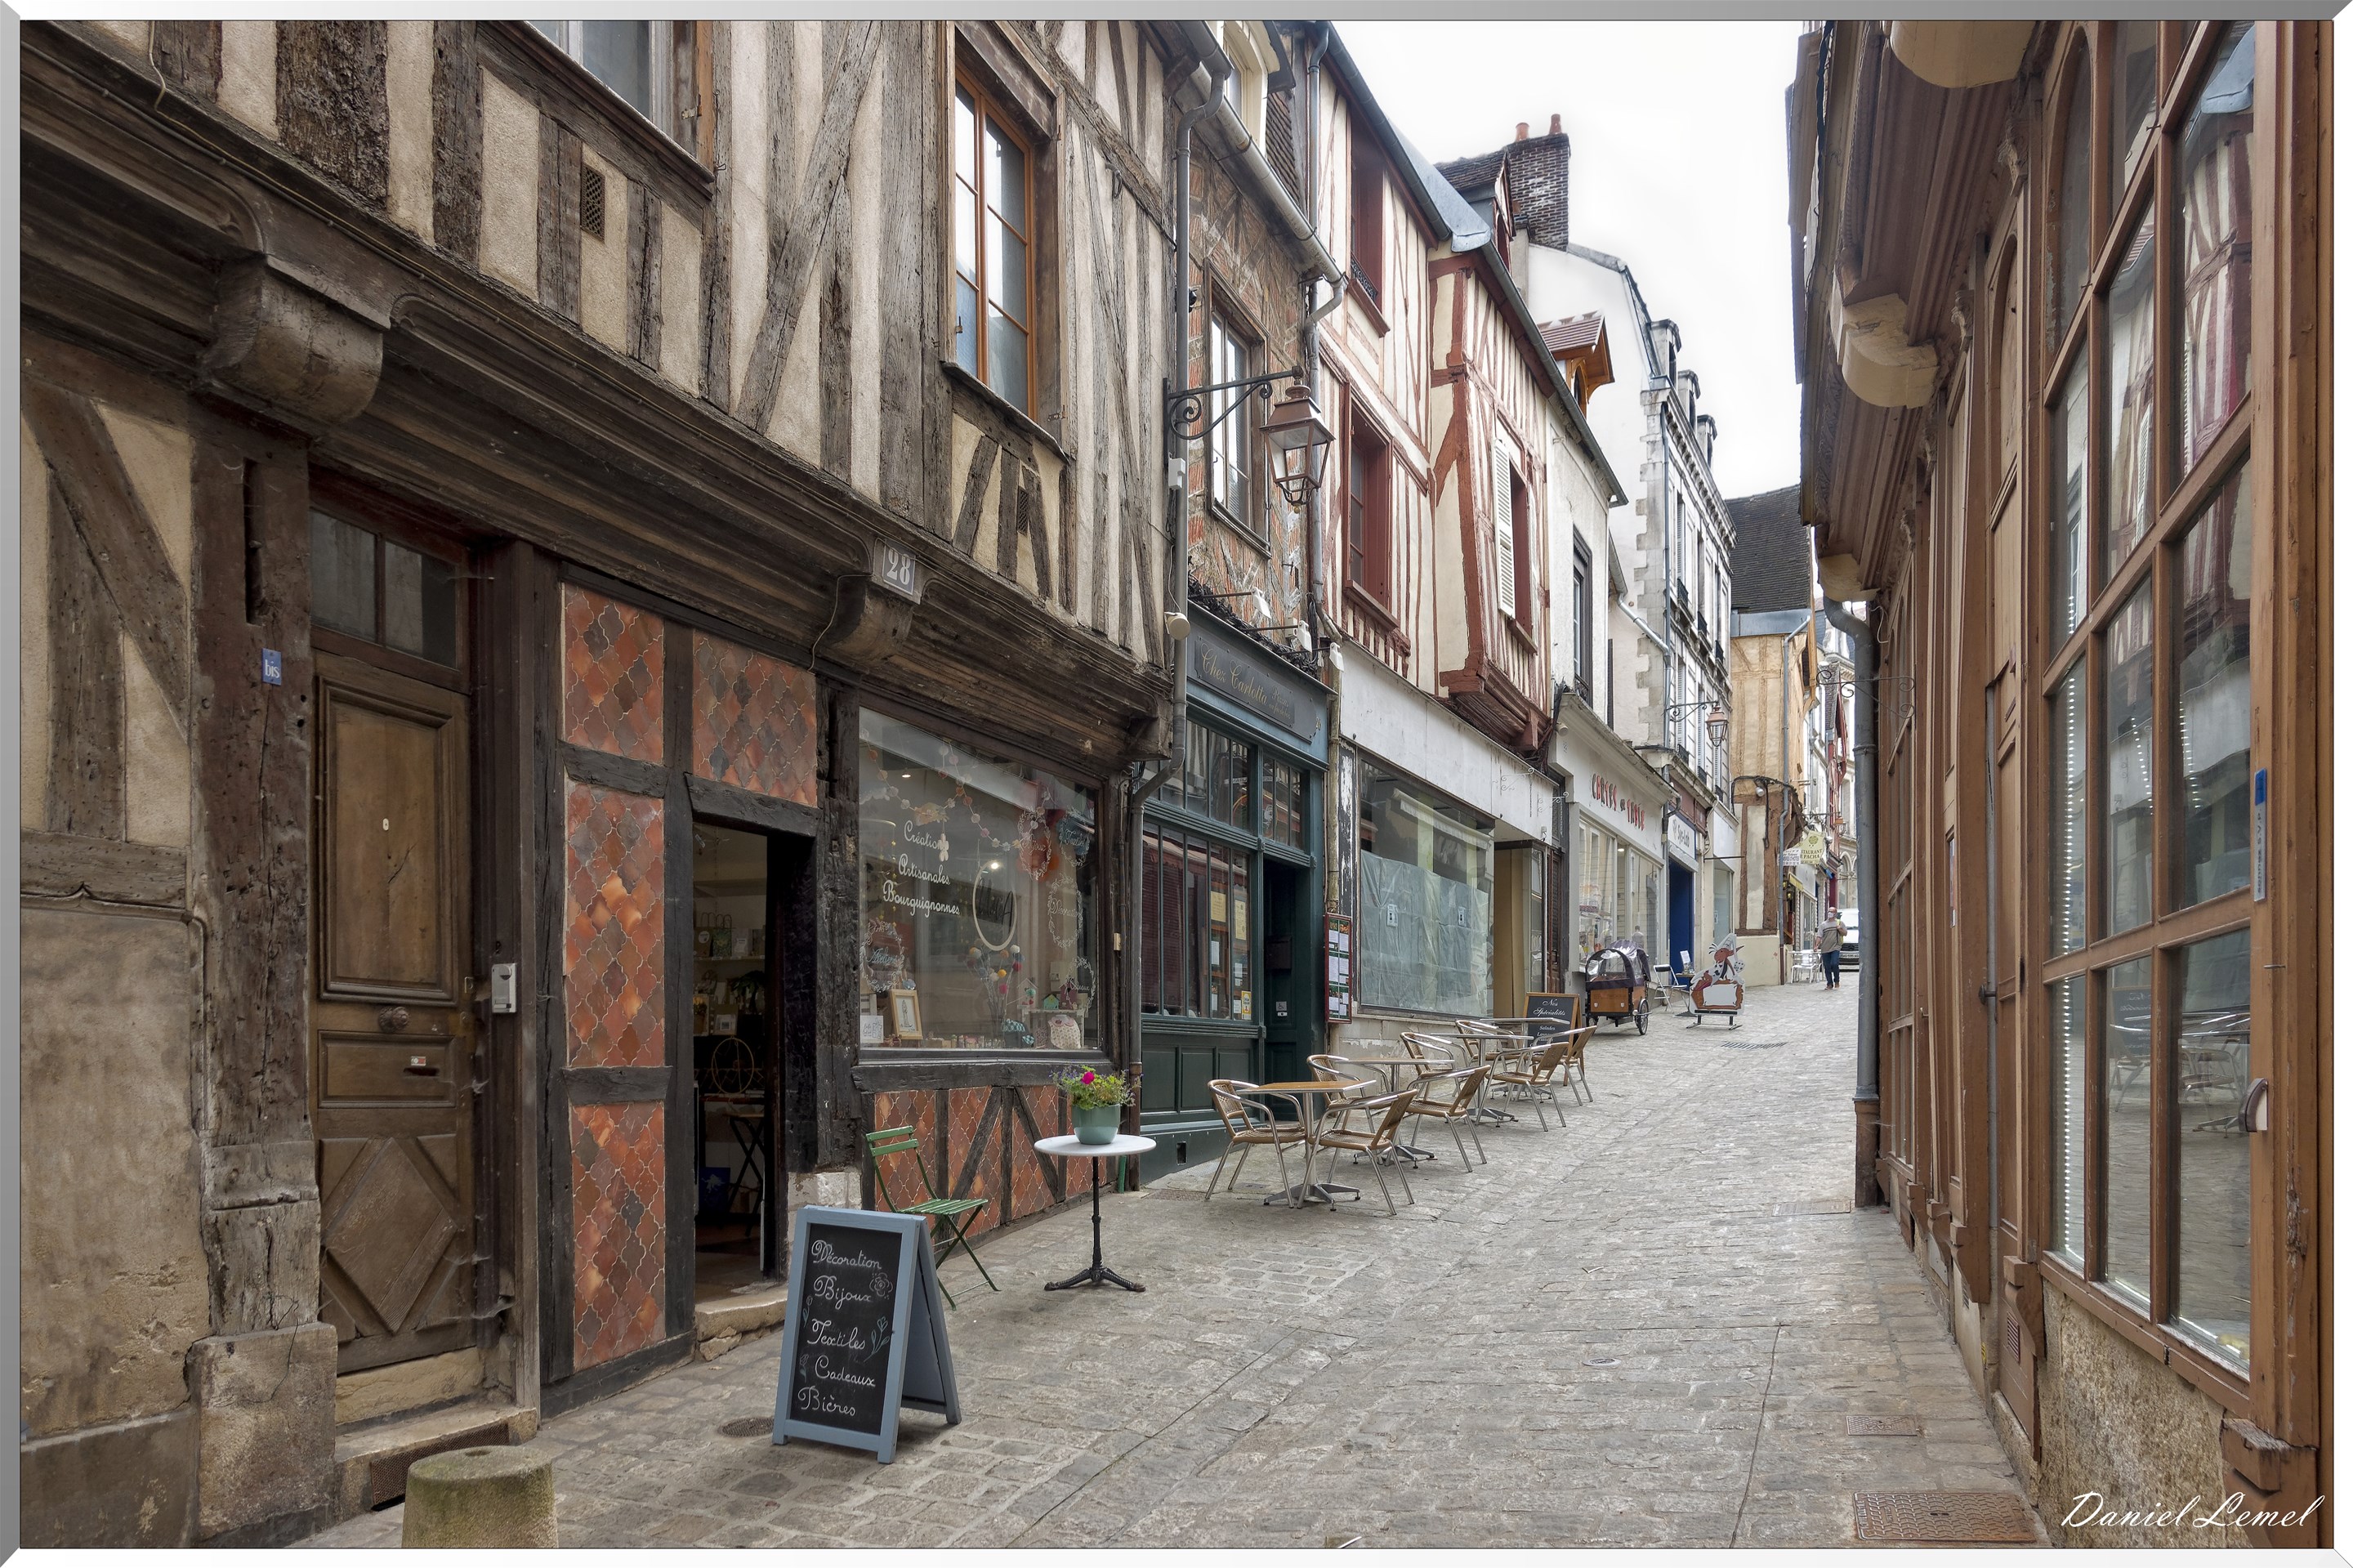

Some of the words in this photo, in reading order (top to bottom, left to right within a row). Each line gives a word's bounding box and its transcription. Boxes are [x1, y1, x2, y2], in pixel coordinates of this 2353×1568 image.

[886, 547, 911, 585] 28
[265, 659, 280, 678] bis
[1201, 643, 1226, 683] Chez
[1230, 660, 1267, 704] Carlotta
[899, 853, 950, 885] Artisanales
[883, 879, 960, 918] Bourguignonnes
[811, 1240, 882, 1270] Décoration
[813, 1275, 873, 1310] Bijoux
[807, 1319, 866, 1350] Textiles
[815, 1355, 876, 1387] Cadeaux
[797, 1386, 856, 1417] Bières
